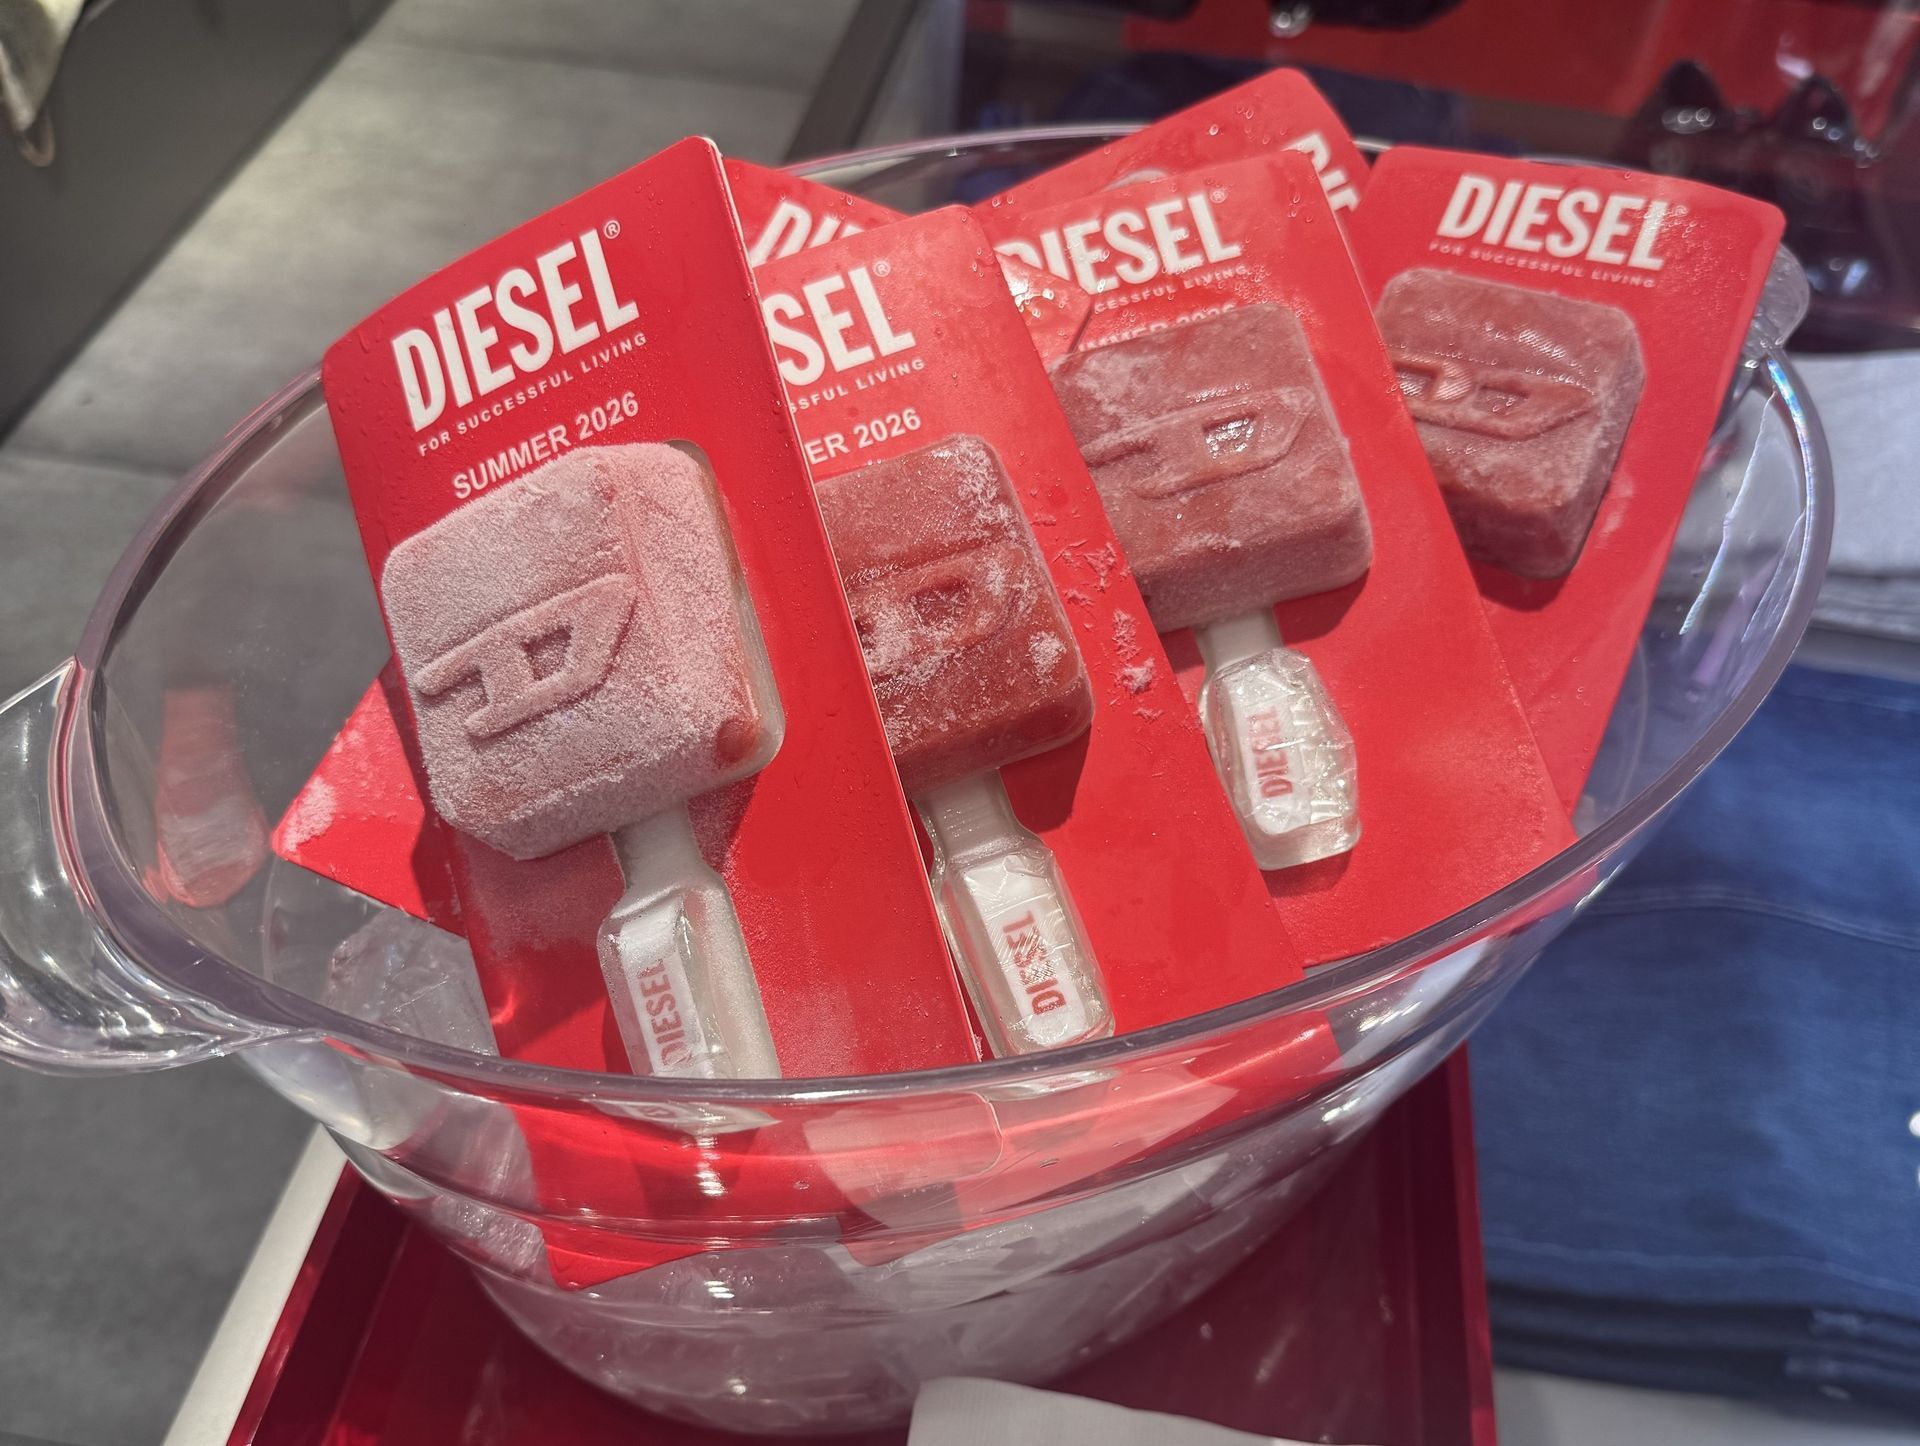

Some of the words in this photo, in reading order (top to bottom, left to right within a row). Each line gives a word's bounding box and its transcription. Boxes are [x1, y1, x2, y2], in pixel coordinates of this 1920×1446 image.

[1469, 248, 1585, 278] SUCCESSFUL
[1591, 269, 1657, 289] LIVING
[418, 430, 451, 457] FOR
[456, 369, 574, 436] SUCCESSFUL
[580, 332, 648, 374] LIVING
[854, 359, 926, 390] LIVING
[453, 424, 572, 499] SUMMER
[575, 391, 639, 440] 2026
[853, 408, 922, 448] 2026
